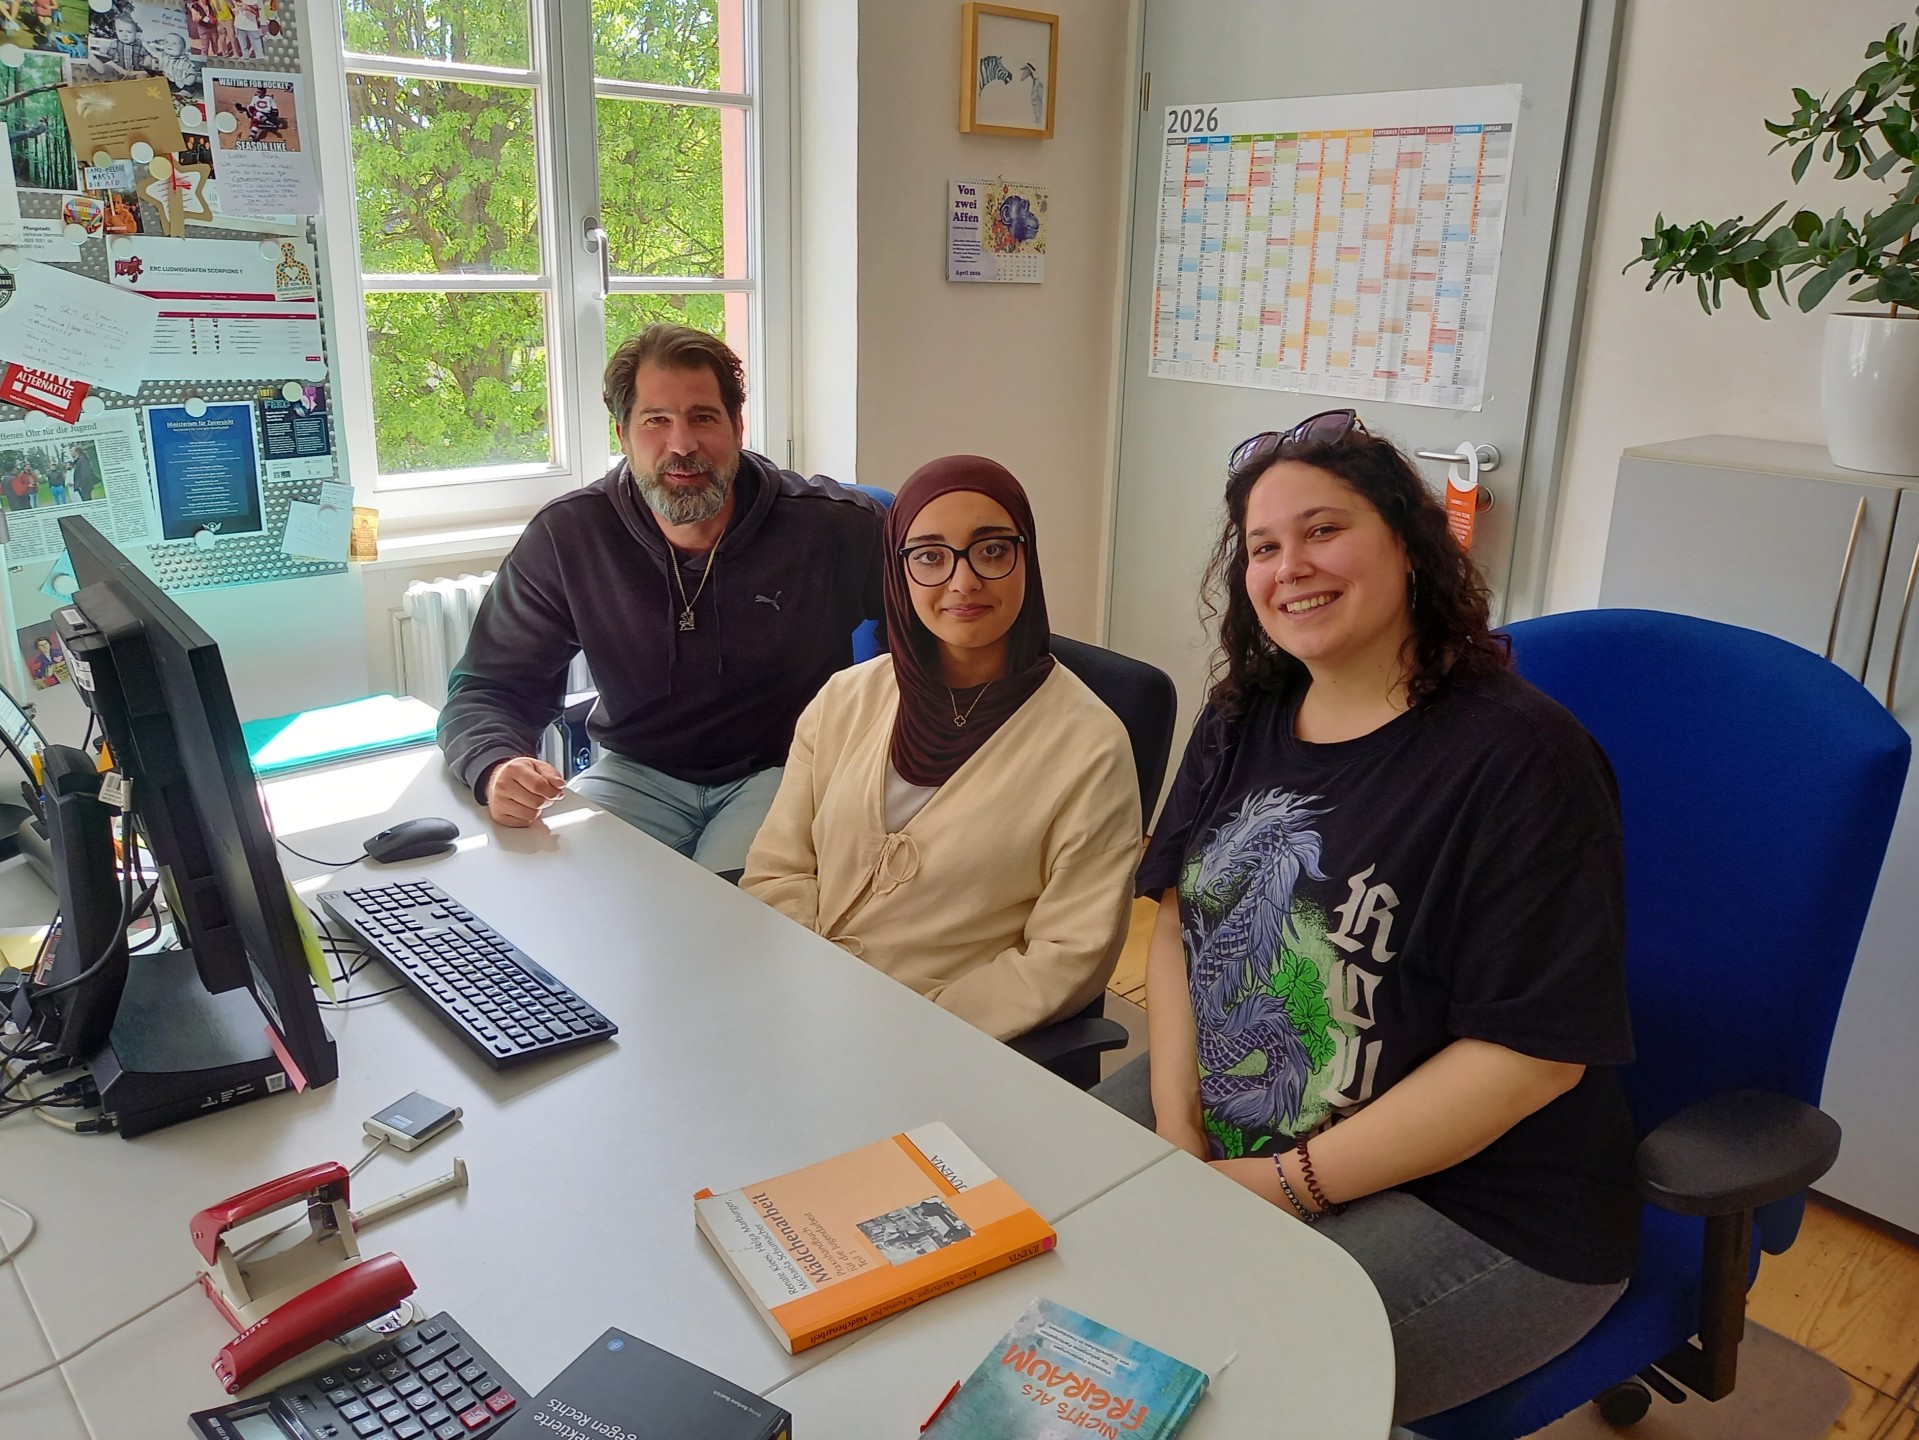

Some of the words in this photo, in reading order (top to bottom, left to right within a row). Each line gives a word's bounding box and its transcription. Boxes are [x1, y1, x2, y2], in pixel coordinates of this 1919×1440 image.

[219, 78, 248, 88] WAITING
[249, 79, 262, 88] FOR
[263, 80, 289, 89] HOCKEY
[1166, 107, 1219, 134] 2026
[235, 141, 268, 151] SEASON
[269, 142, 287, 152] LIKE
[957, 184, 976, 196] Von
[952, 212, 980, 223] Affen
[954, 199, 978, 210] zwei
[16, 371, 75, 399] ALTERNATIVE
[25, 429, 41, 437] Ohr
[42, 427, 55, 436] für
[56, 425, 69, 434] die
[70, 422, 98, 433] Jugend
[166, 420, 198, 428] Ministerium
[930, 1154, 968, 1191] JUVENTA
[725, 1199, 752, 1234] Marburger,
[750, 1233, 766, 1253] Helga
[752, 1191, 832, 1284] Mädchenarbeit
[754, 1223, 787, 1261] Schumacher
[804, 1211, 840, 1250] Jugendarbeit
[803, 1227, 847, 1277] Praxishandbuch
[777, 1272, 799, 1295] Renate
[785, 1259, 810, 1290] Michaela
[810, 1313, 869, 1343] Mädchenarbeit
[1053, 1344, 1088, 1363] Forderungen
[1001, 1343, 1149, 1431] FREIRAUM
[1021, 1383, 1056, 1406] ALS
[547, 1398, 593, 1428] Rechts
[1056, 1402, 1119, 1440] NICHTS
